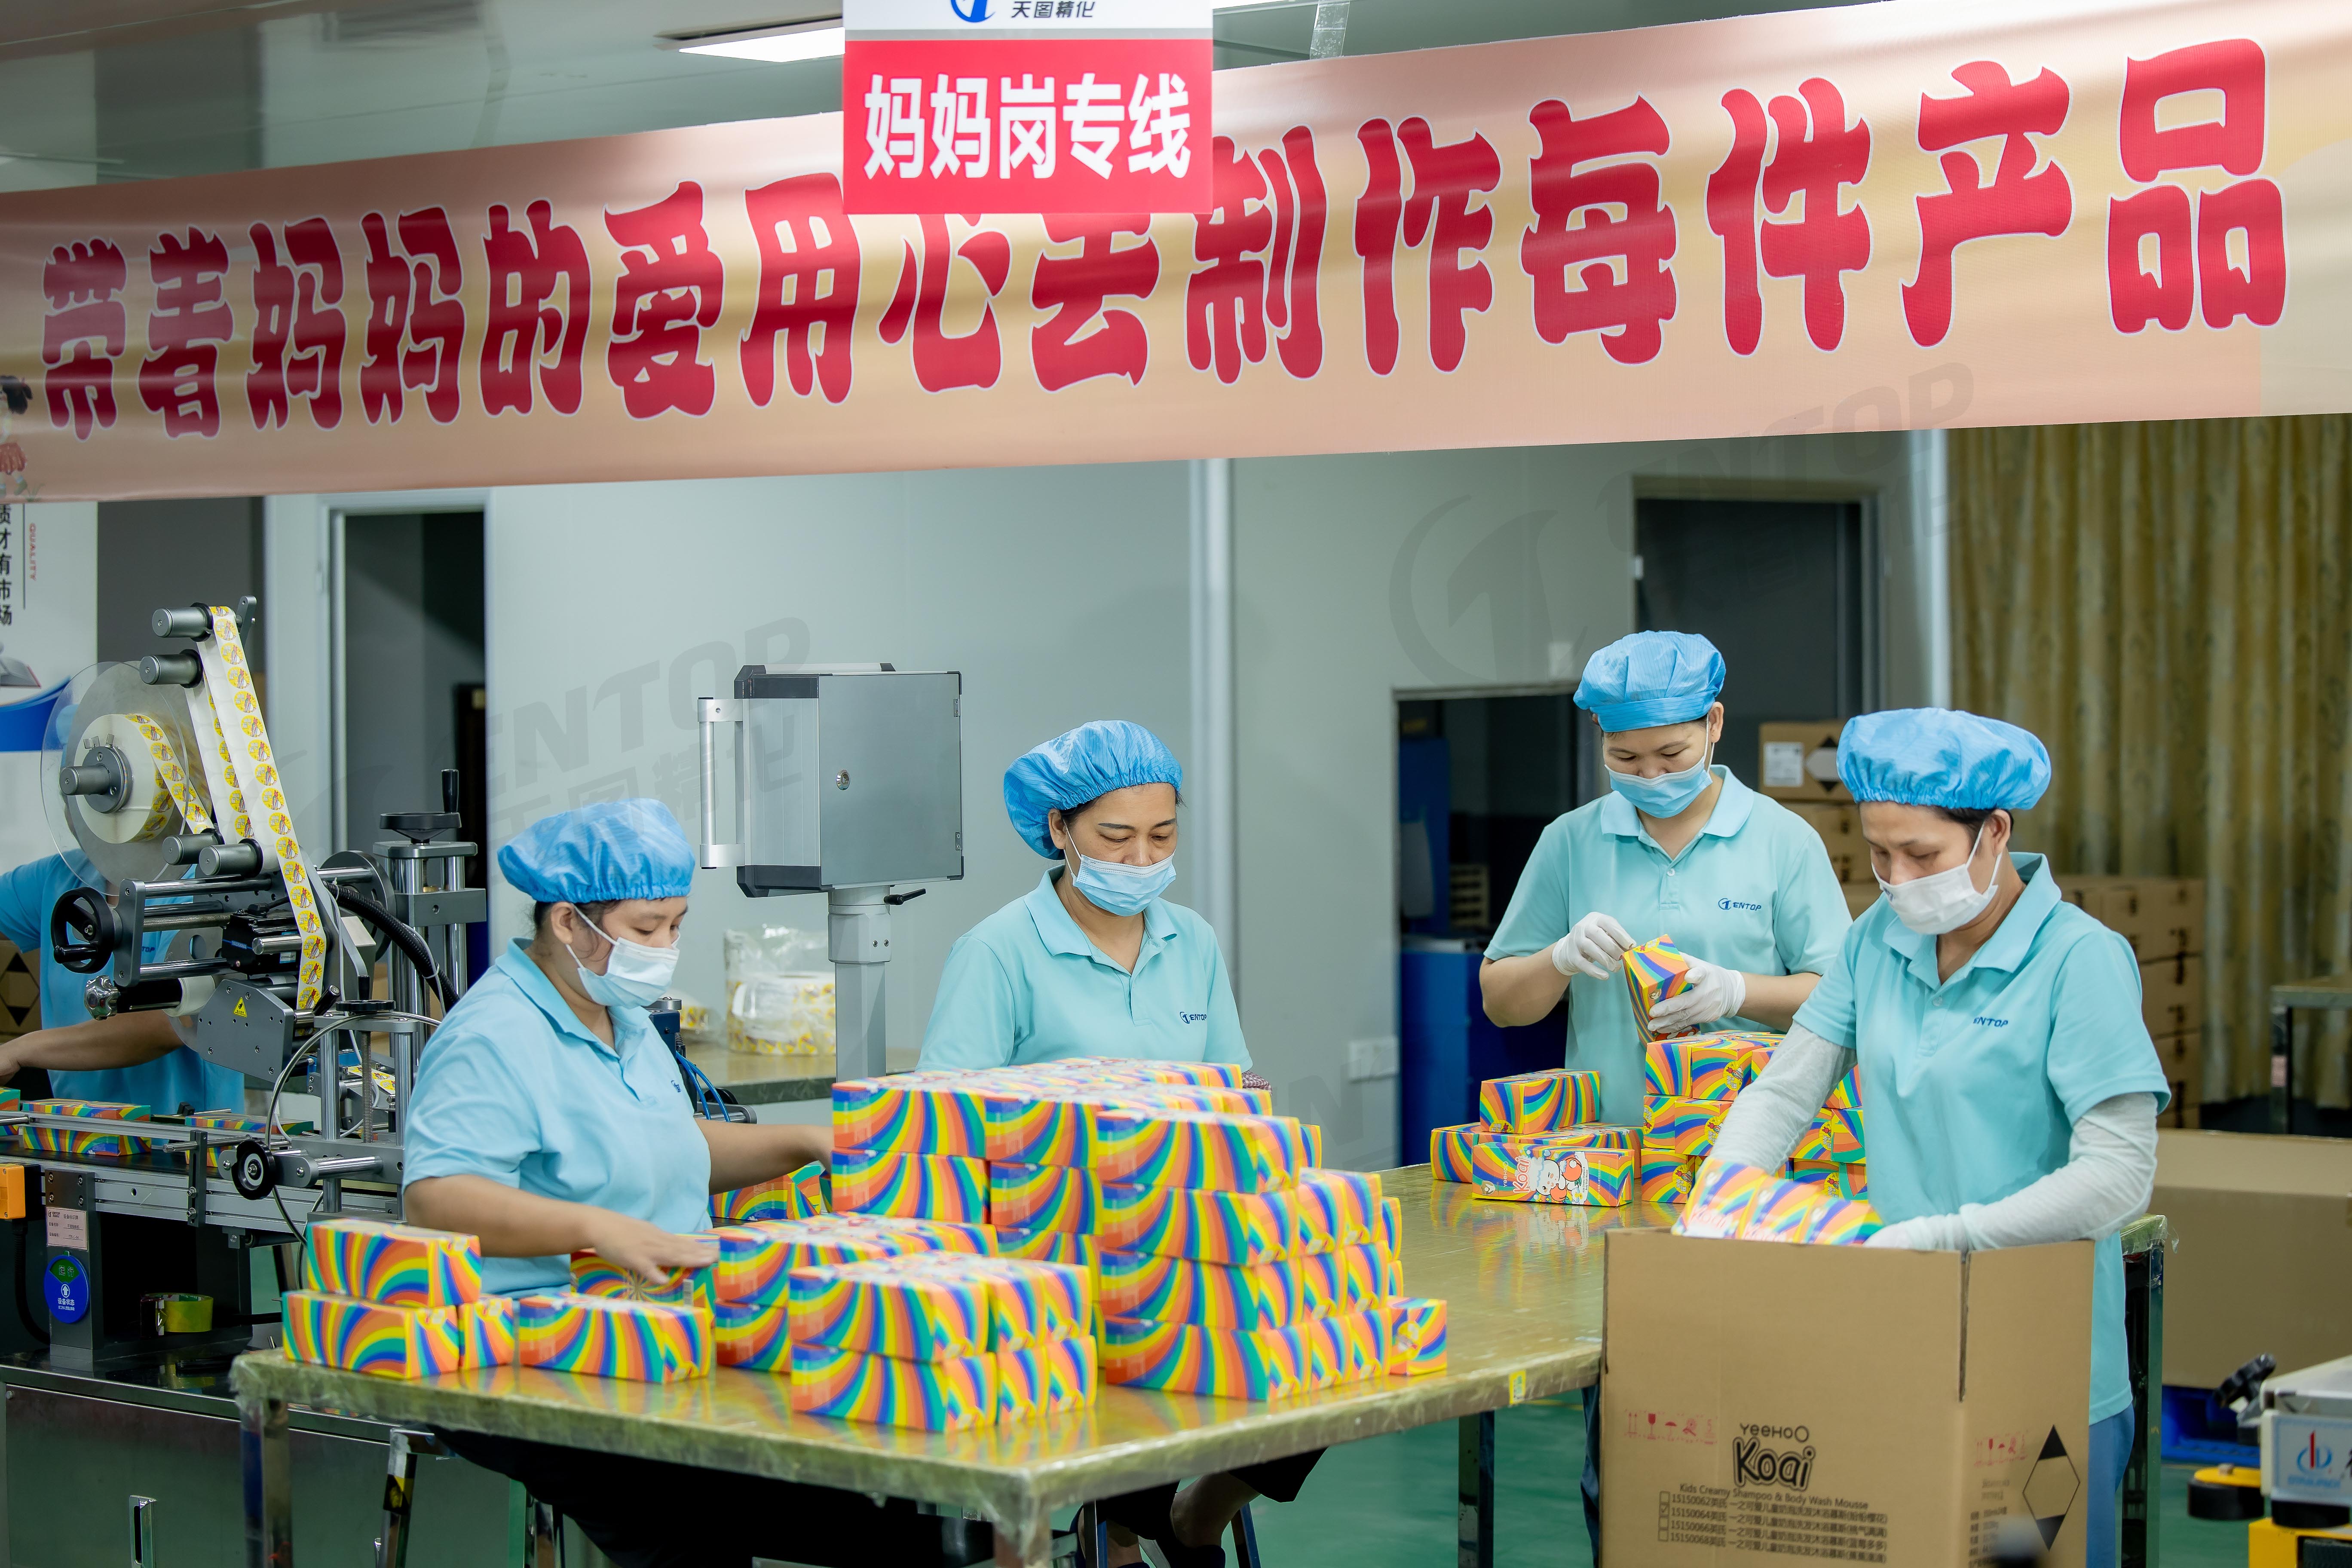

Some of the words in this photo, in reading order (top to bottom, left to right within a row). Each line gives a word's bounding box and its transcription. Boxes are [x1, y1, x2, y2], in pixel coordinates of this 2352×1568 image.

[1011, 1, 1094, 18] 天图精化
[863, 73, 1191, 180] 妈妈岗专线
[29, 523, 37, 581] QUALITY
[1733, 902, 1761, 911] ENTOP
[1512, 1157, 1531, 1194] Koai
[59, 1265, 74, 1277] 运行
[58, 1298, 75, 1306] 设备状态
[1733, 1437, 1816, 1492] Koai
[1680, 1483, 1697, 1494] Kids
[1699, 1485, 1730, 1499] Creamy
[1733, 1488, 1773, 1503] Shampoo
[1785, 1492, 1806, 1507] Body
[1809, 1495, 1832, 1507] Wash
[1834, 1498, 1869, 1510] Mousse
